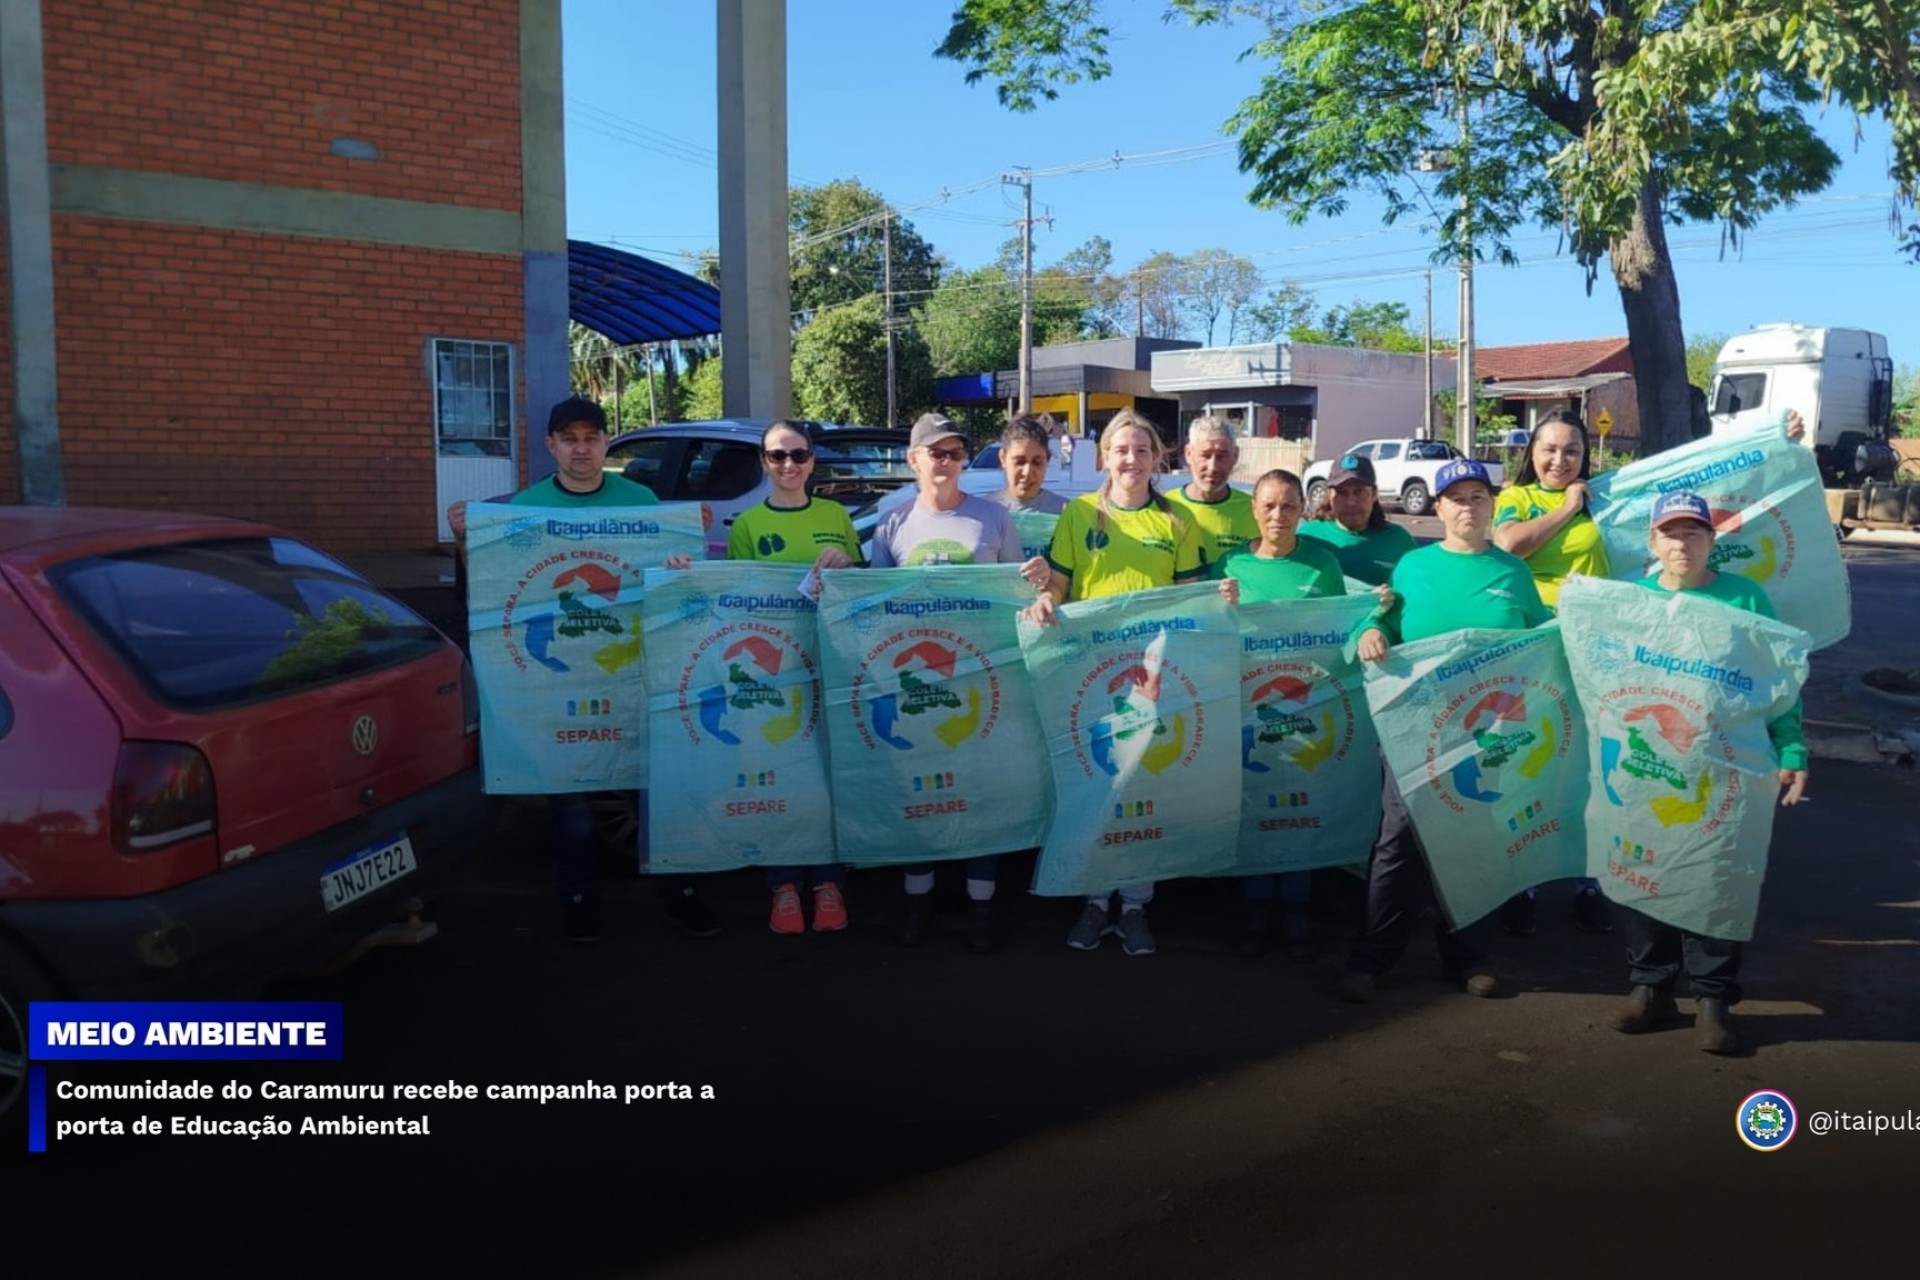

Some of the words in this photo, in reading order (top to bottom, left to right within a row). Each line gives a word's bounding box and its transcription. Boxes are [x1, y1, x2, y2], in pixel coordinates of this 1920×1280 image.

[526, 551, 569, 580] CIDADE
[570, 549, 620, 566] CRESCE
[699, 624, 737, 652] CIDADE
[738, 621, 783, 638] CRESCE
[867, 630, 906, 662] CIDADE
[908, 628, 957, 641] CRESCE
[1082, 656, 1117, 688] CIDADE
[1434, 694, 1468, 729] CIDADE
[1469, 675, 1516, 695] CRESCE
[1651, 686, 1704, 714] CRESCE
[555, 727, 624, 745] SEPARE
[725, 799, 788, 817] SEPARE
[903, 798, 968, 820] SEPARE
[1103, 826, 1165, 847] SEPARE
[1258, 816, 1321, 832] SEPARE
[1505, 818, 1561, 859] SEPARE
[333, 847, 406, 902] JNJ7E22
[1610, 860, 1660, 897] EPARE
